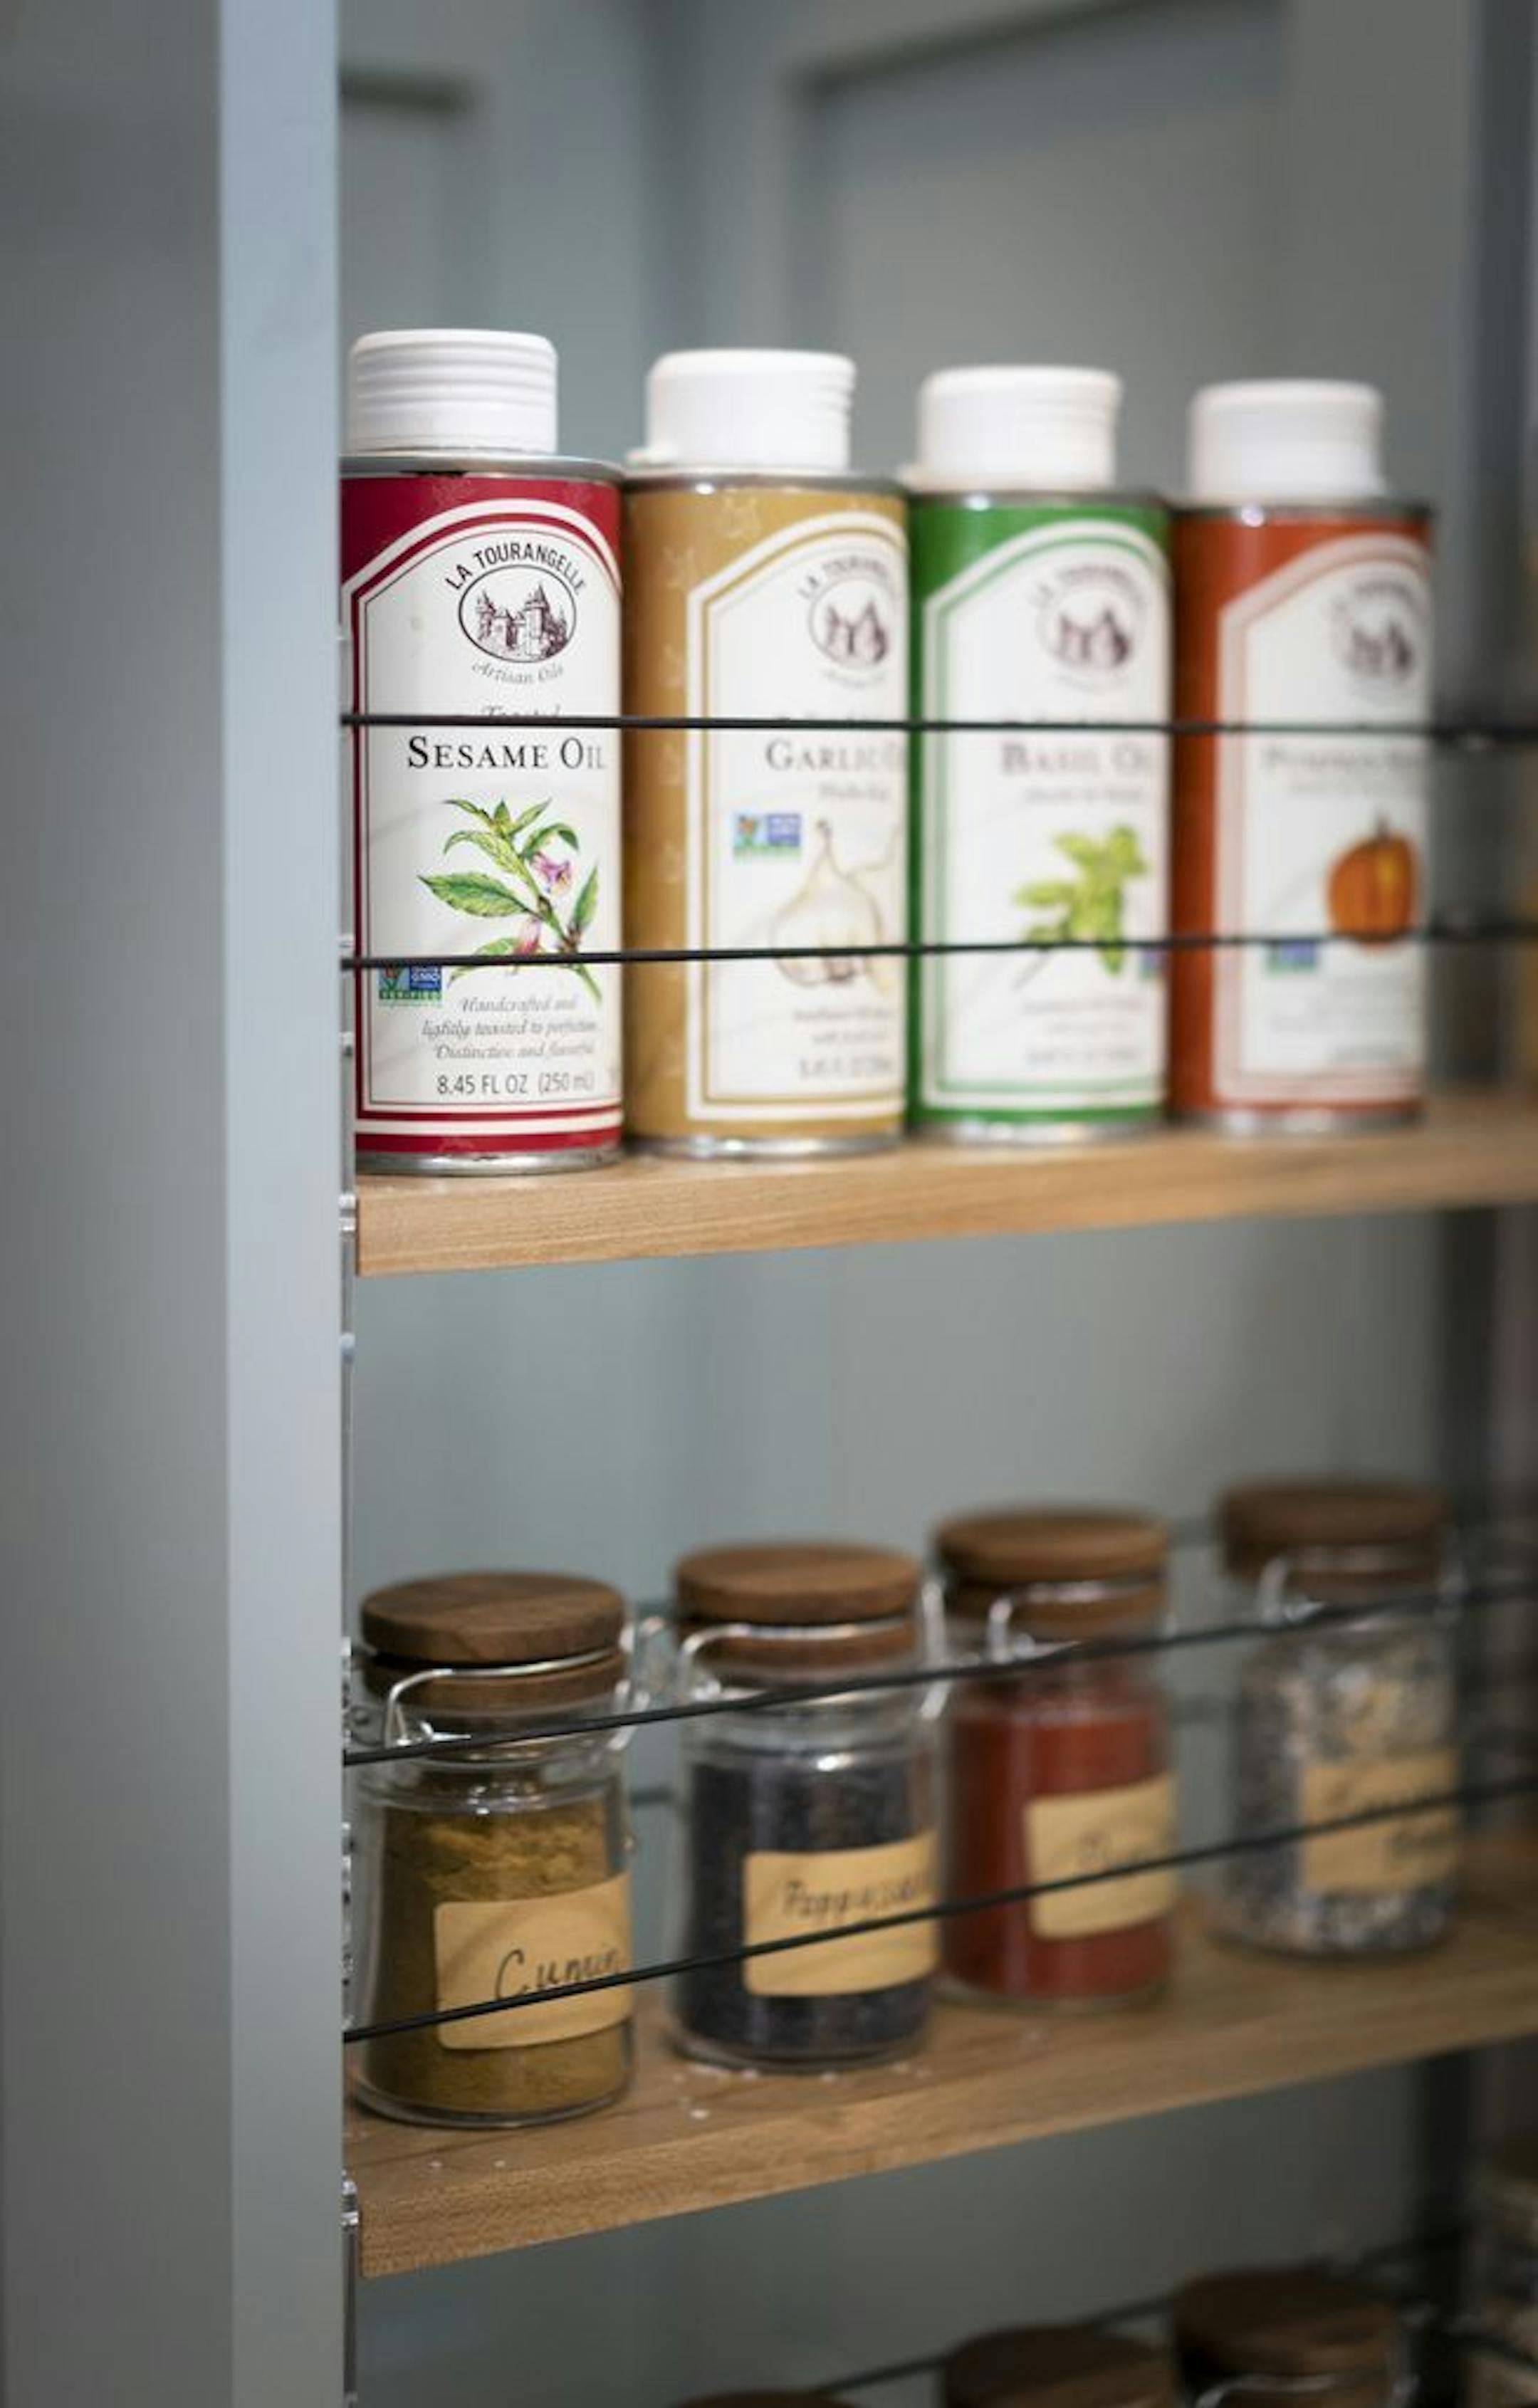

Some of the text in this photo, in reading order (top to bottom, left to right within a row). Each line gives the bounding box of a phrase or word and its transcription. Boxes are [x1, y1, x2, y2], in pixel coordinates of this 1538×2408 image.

[444, 541, 587, 597] LA TOURANGELLE
[407, 735, 605, 770] SESAME OIL
[436, 1074, 476, 1095] 8.45
[481, 1074, 500, 1094] FL
[505, 1074, 529, 1094] OZ
[538, 1072, 570, 1094] (250
